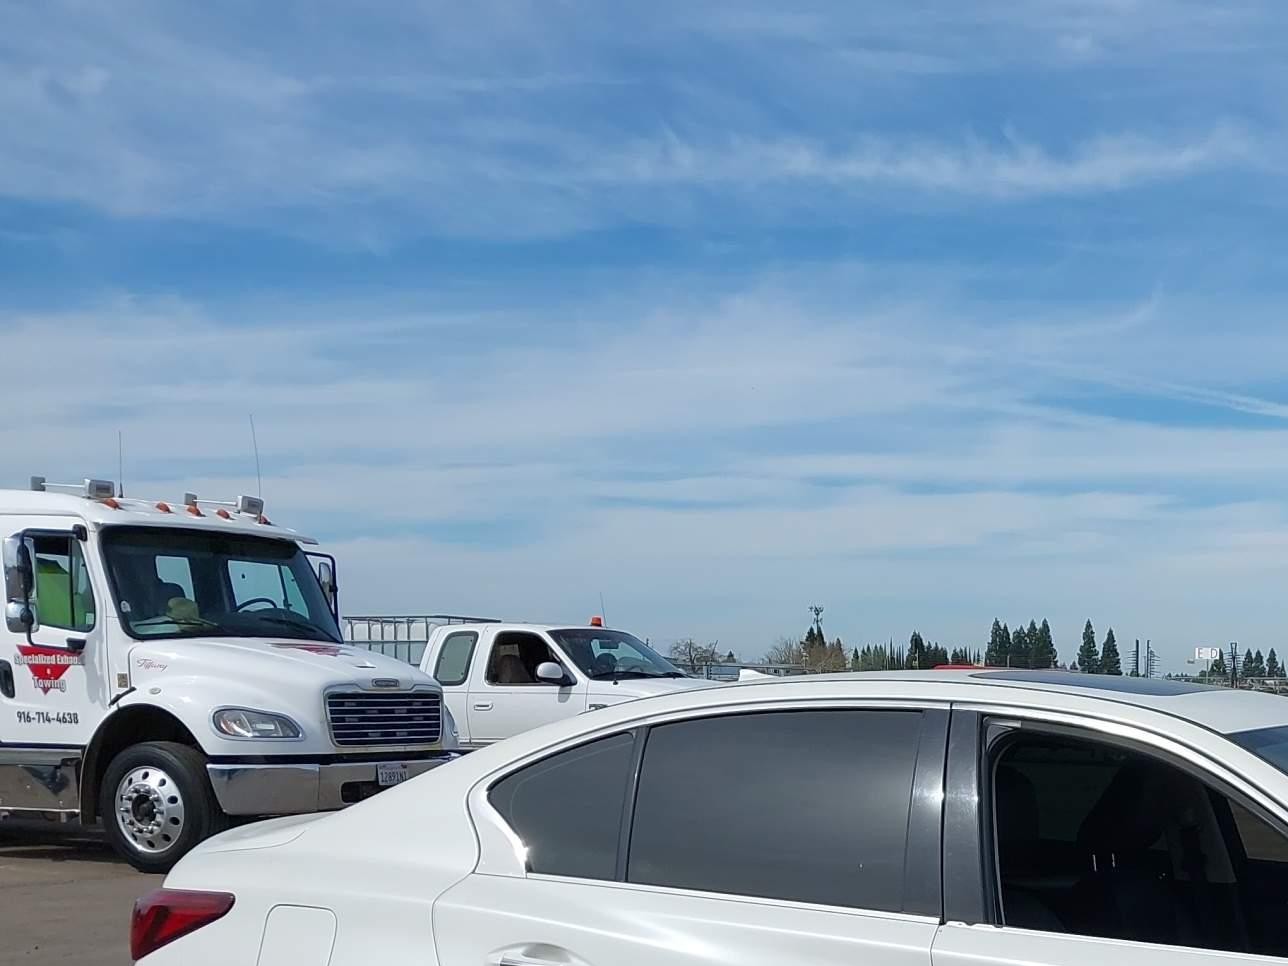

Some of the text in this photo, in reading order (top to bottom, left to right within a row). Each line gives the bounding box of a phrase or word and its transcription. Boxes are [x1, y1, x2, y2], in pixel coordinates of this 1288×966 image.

[14, 653, 55, 665] Specialized
[32, 675, 66, 692] Towing
[16, 711, 79, 723] 916-714-4638
